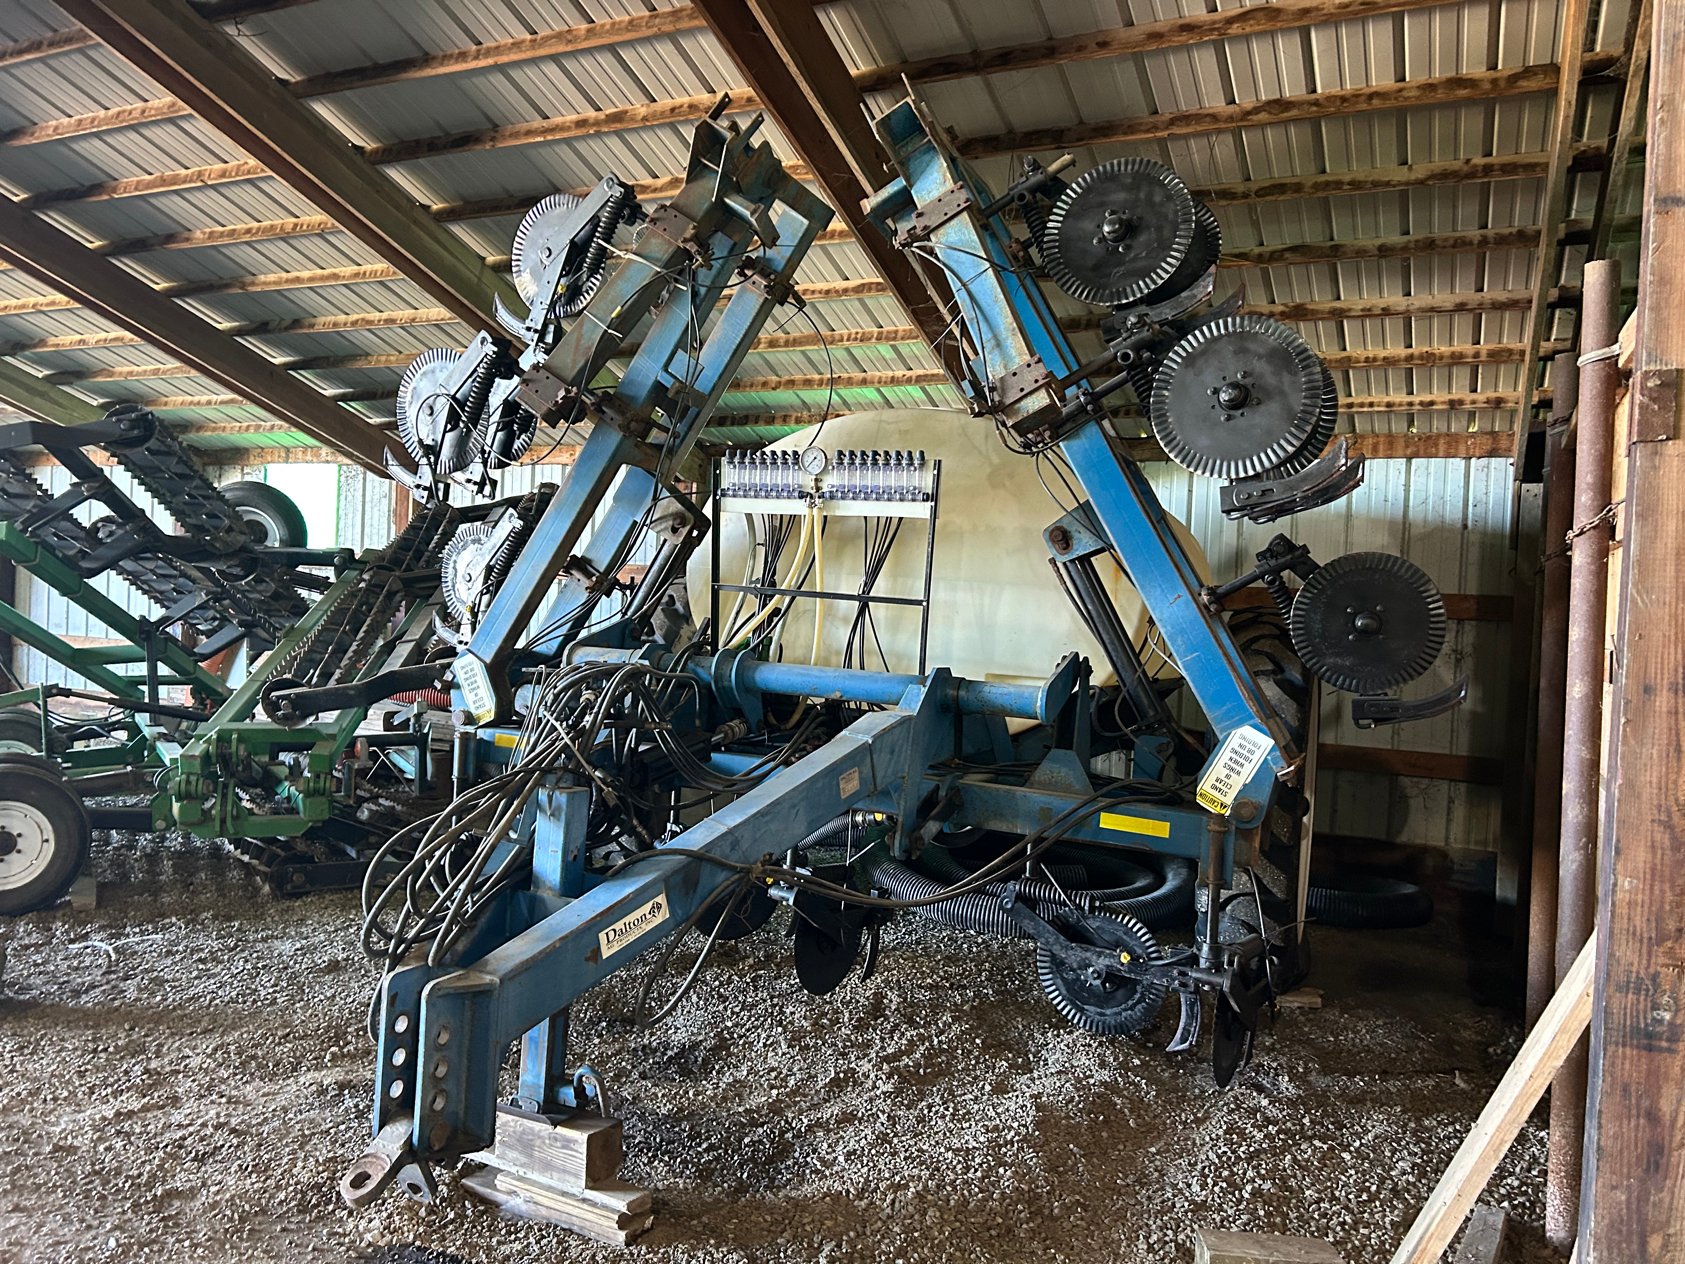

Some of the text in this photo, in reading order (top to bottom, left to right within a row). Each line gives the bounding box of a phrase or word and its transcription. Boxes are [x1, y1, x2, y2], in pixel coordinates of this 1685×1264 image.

[1238, 732, 1262, 751] FOLDING
[1229, 746, 1253, 764] FOLDING
[1246, 747, 1256, 756] OR
[1222, 761, 1243, 777] WINGS
[1227, 755, 1246, 770] WHEN
[1214, 776, 1233, 791] CLEAR
[1224, 772, 1232, 781] OF
[1209, 782, 1229, 798] STAND
[1197, 790, 1221, 809] CAUTION
[604, 912, 648, 945] Dalton
